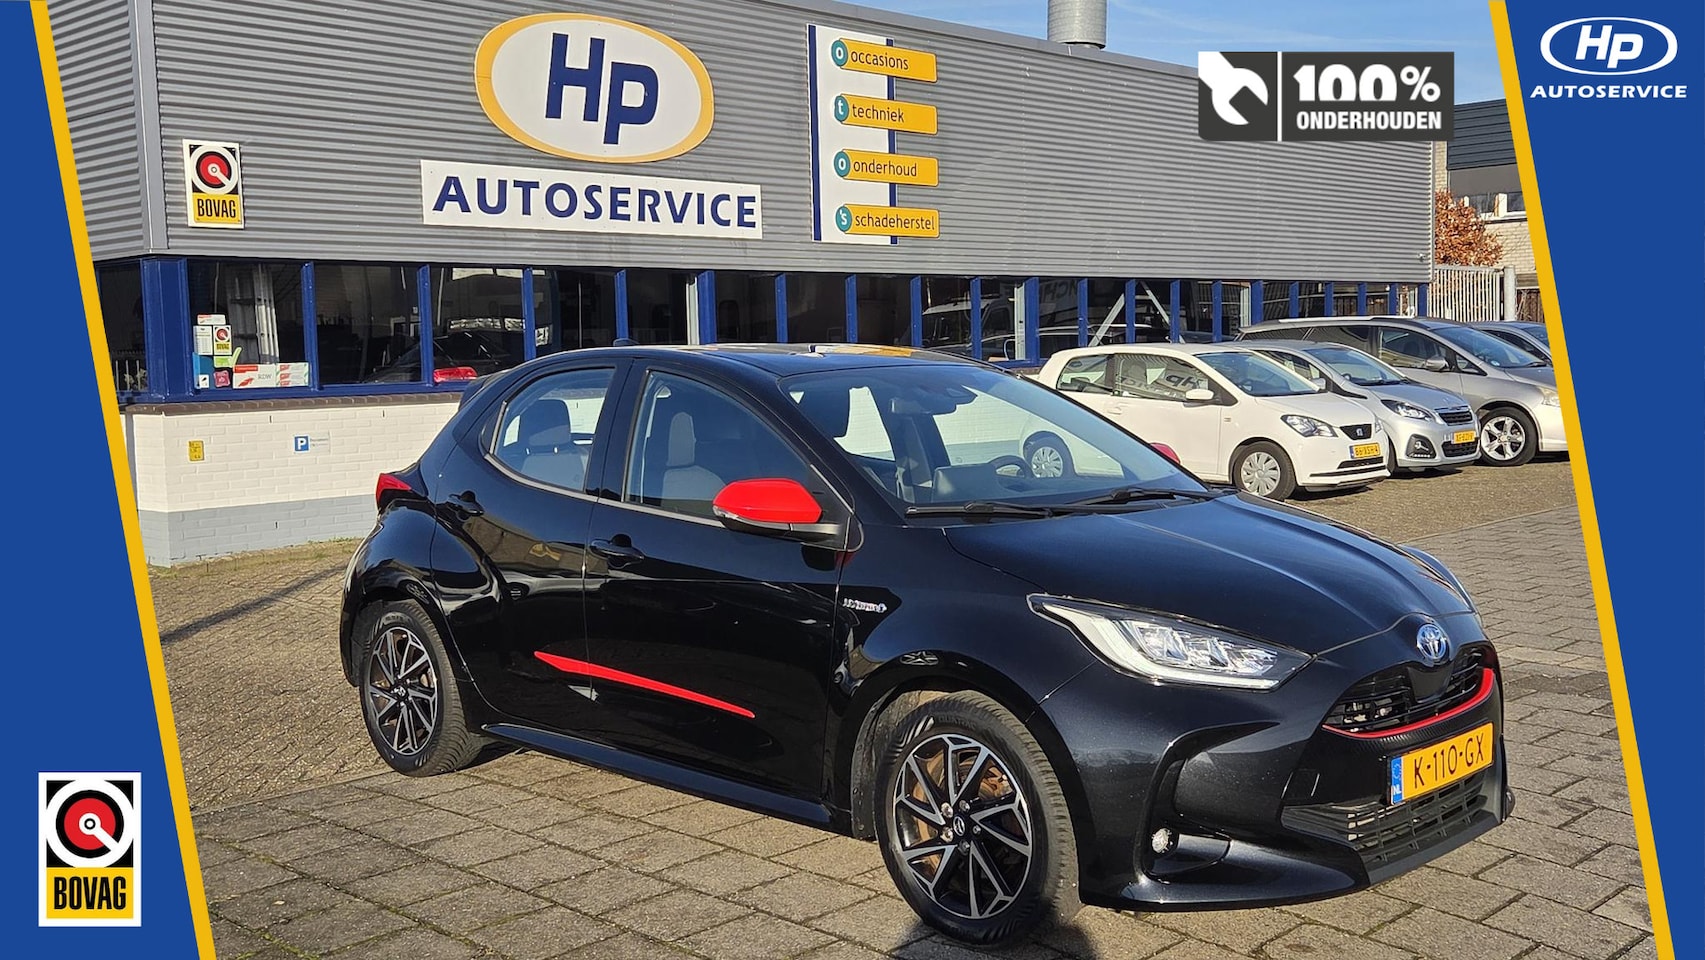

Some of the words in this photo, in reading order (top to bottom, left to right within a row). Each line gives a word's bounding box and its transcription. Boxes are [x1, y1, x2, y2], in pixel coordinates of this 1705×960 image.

[850, 50, 909, 70] occasions
[837, 99, 844, 115] t
[852, 103, 905, 123] techniek
[853, 159, 917, 177] onderhoud
[196, 198, 237, 218] BOVAG
[432, 175, 757, 228] AUTOSERVICE
[855, 212, 935, 231] schadeherstel
[297, 437, 307, 450] P
[1414, 732, 1484, 789] K-110-GX
